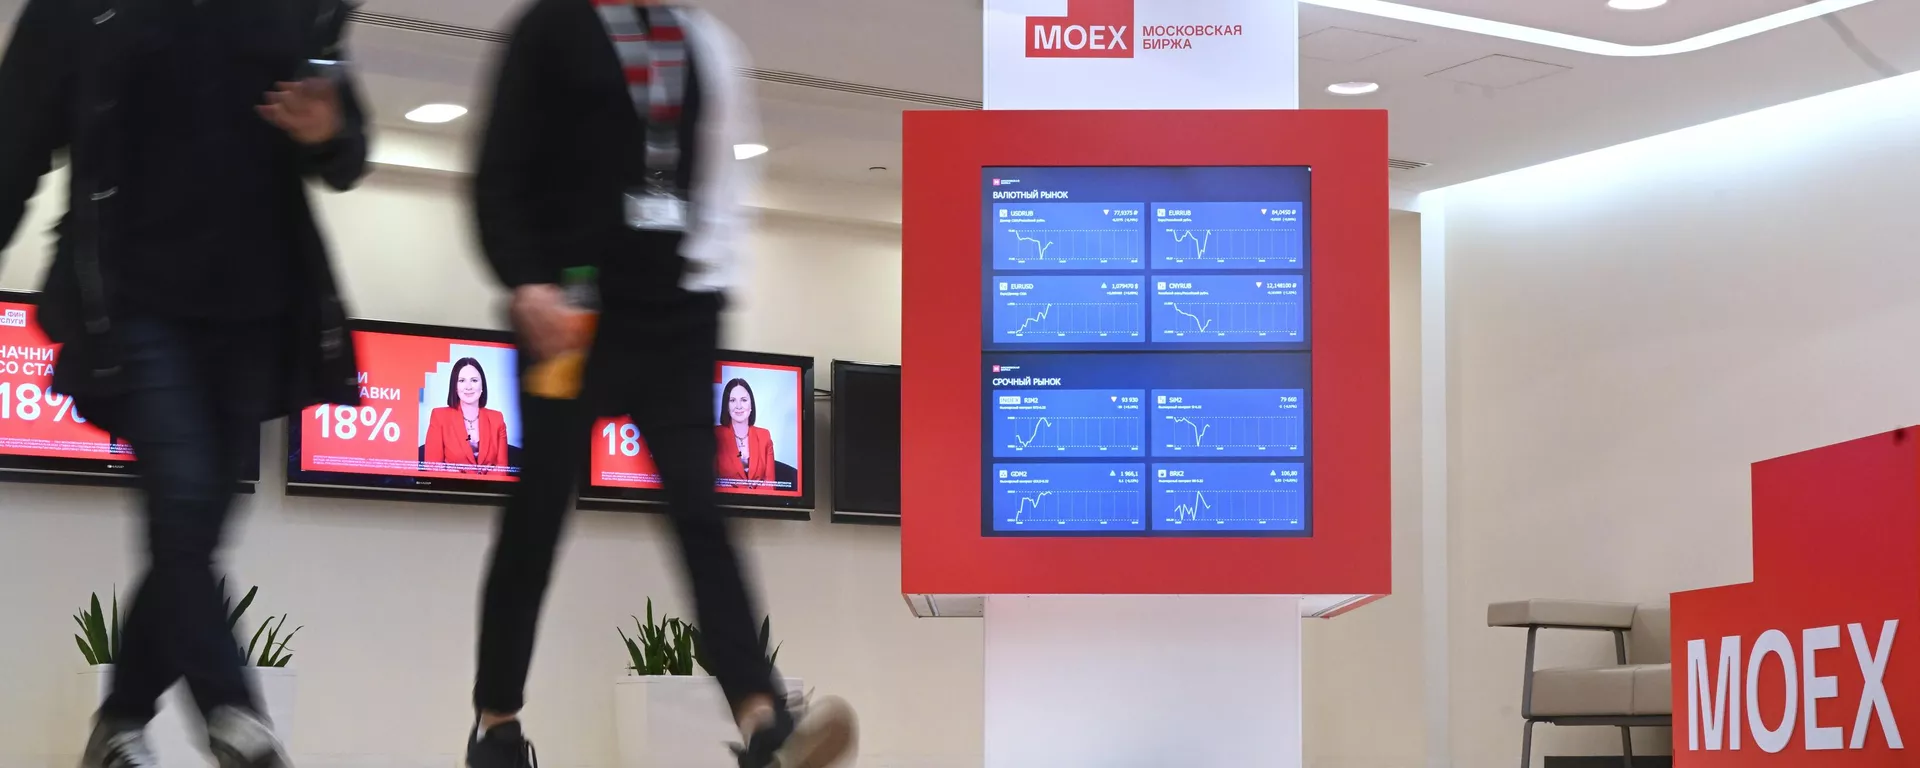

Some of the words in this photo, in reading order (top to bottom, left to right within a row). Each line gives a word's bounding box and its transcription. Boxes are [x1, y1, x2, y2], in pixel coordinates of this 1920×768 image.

[1034, 25, 1128, 50] MOEX
[1142, 25, 1242, 37] МОСКОВСКАЯ
[1142, 38, 1193, 51] БИРЖА
[993, 189, 1039, 199] ВАЛЮТНЫЙ
[1040, 191, 1069, 199] РЫНОК
[23, 362, 54, 377] СТА
[993, 376, 1032, 386] СРОЧНЫЙ
[1033, 378, 1061, 386] РЫНОК
[359, 386, 401, 401] АВКИ
[314, 403, 400, 442] 18%
[602, 422, 641, 457] 18
[1687, 619, 1904, 753] MOEX
